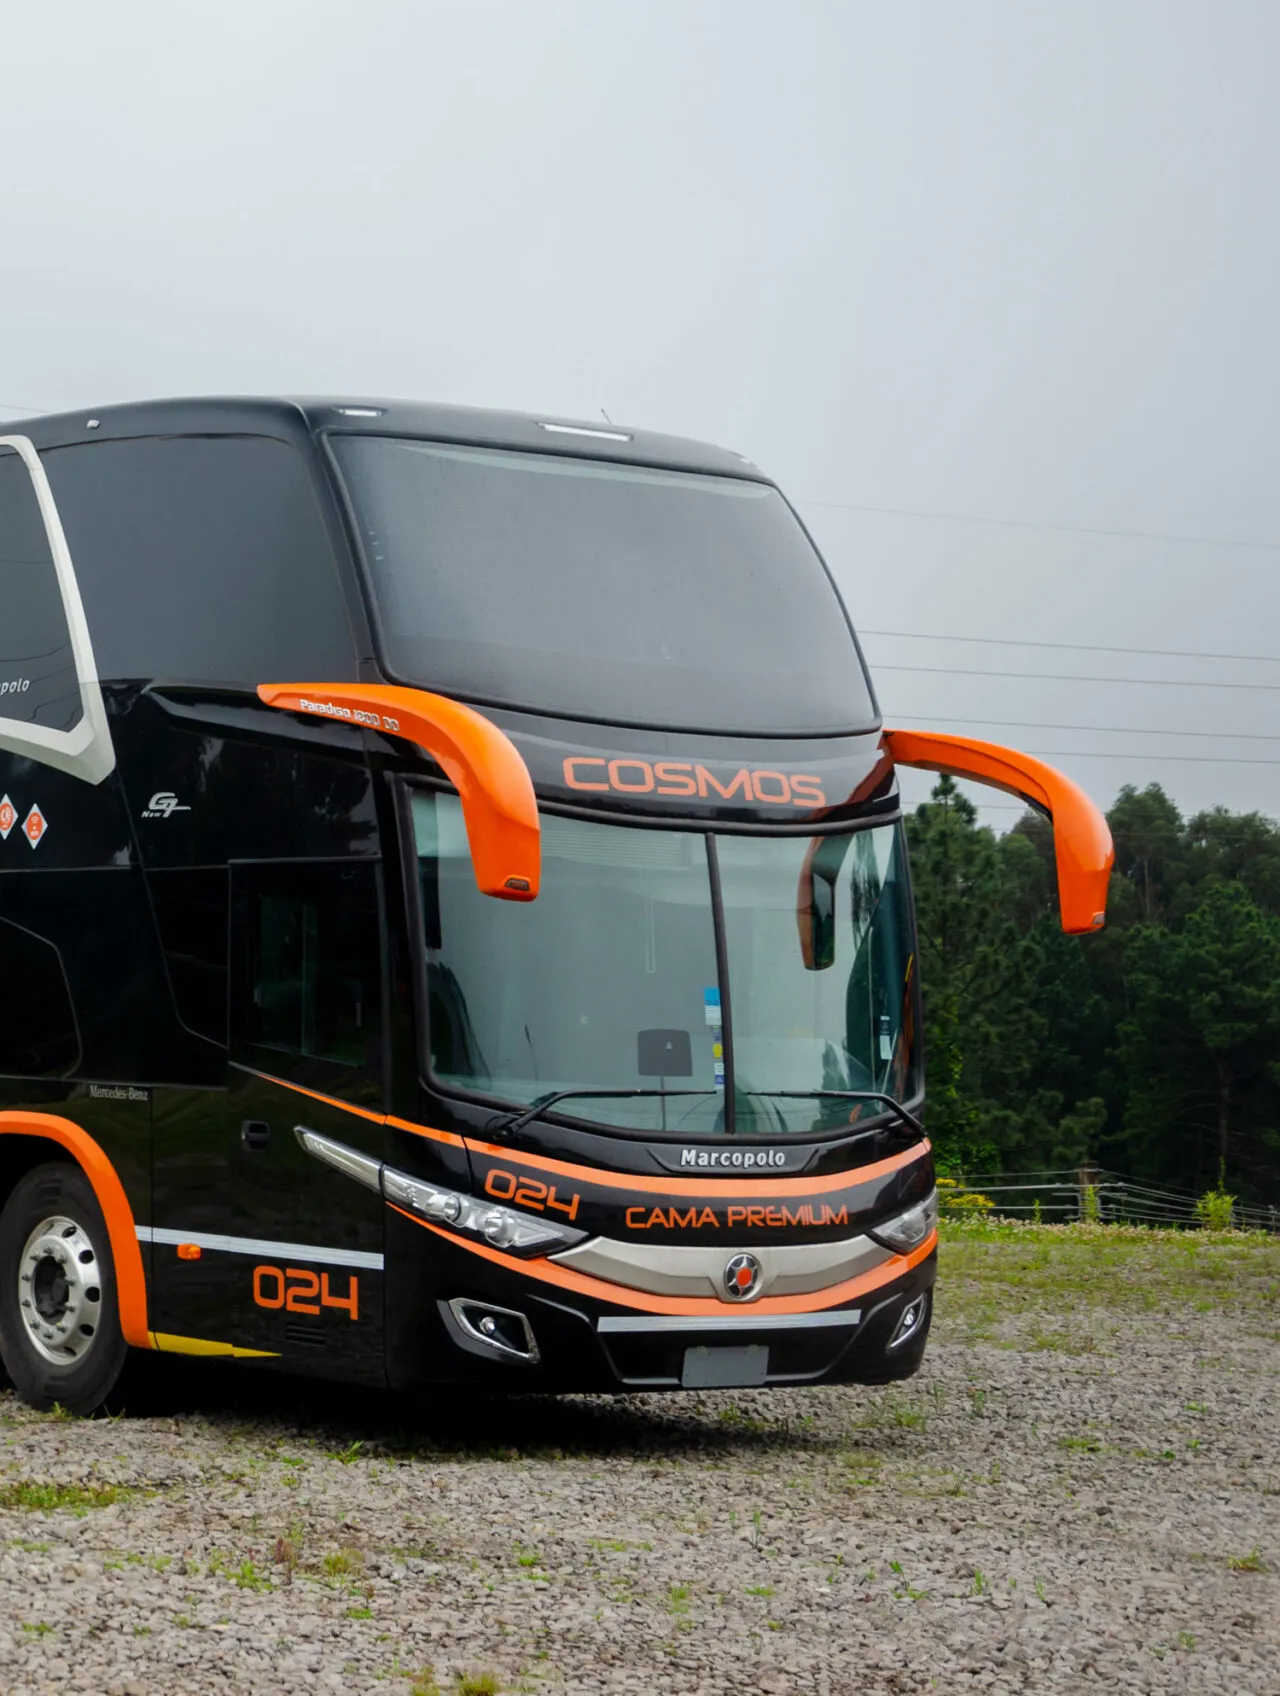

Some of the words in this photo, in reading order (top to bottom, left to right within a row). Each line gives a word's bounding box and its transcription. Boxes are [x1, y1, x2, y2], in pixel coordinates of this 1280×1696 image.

[300, 698, 351, 719] Paradiso
[562, 756, 826, 808] COSMOS
[89, 1084, 149, 1101] Mercedes-Benz
[681, 1149, 786, 1169] Marcopolo
[484, 1168, 580, 1221] 024
[626, 1206, 720, 1229] CAMA
[727, 1204, 848, 1228] PREMIUM
[253, 1265, 358, 1321] 024
